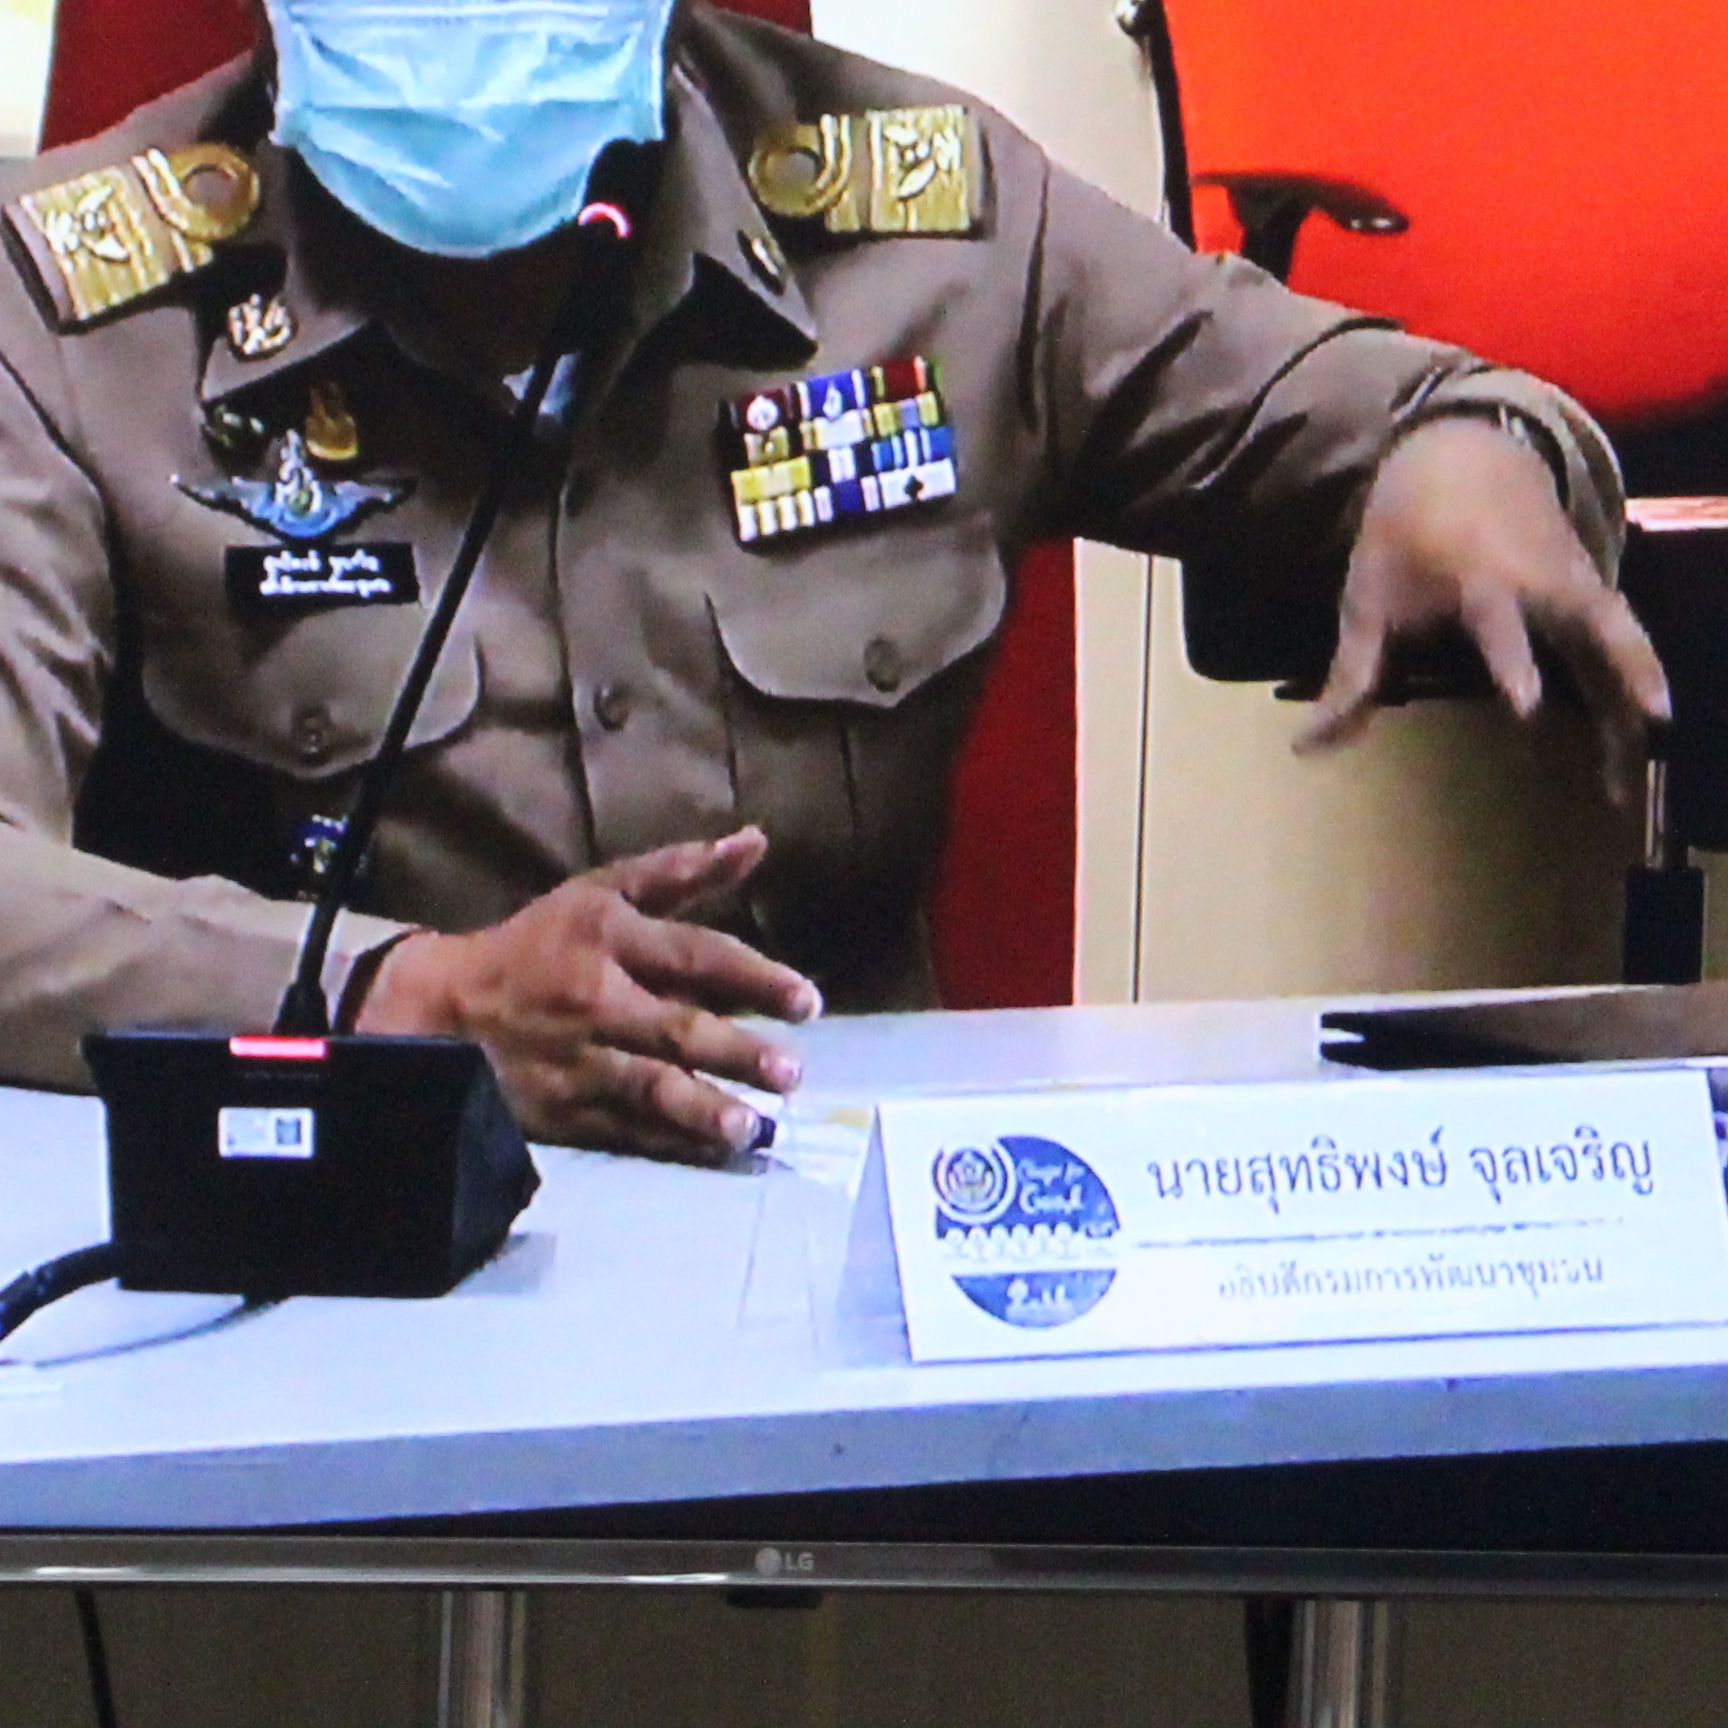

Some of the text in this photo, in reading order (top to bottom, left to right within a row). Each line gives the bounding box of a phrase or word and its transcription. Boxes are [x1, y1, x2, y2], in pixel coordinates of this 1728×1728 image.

[1146, 1125, 1447, 1215] นายสุทธิพงษ์
[1469, 1124, 1654, 1205] จุลเจริญ
